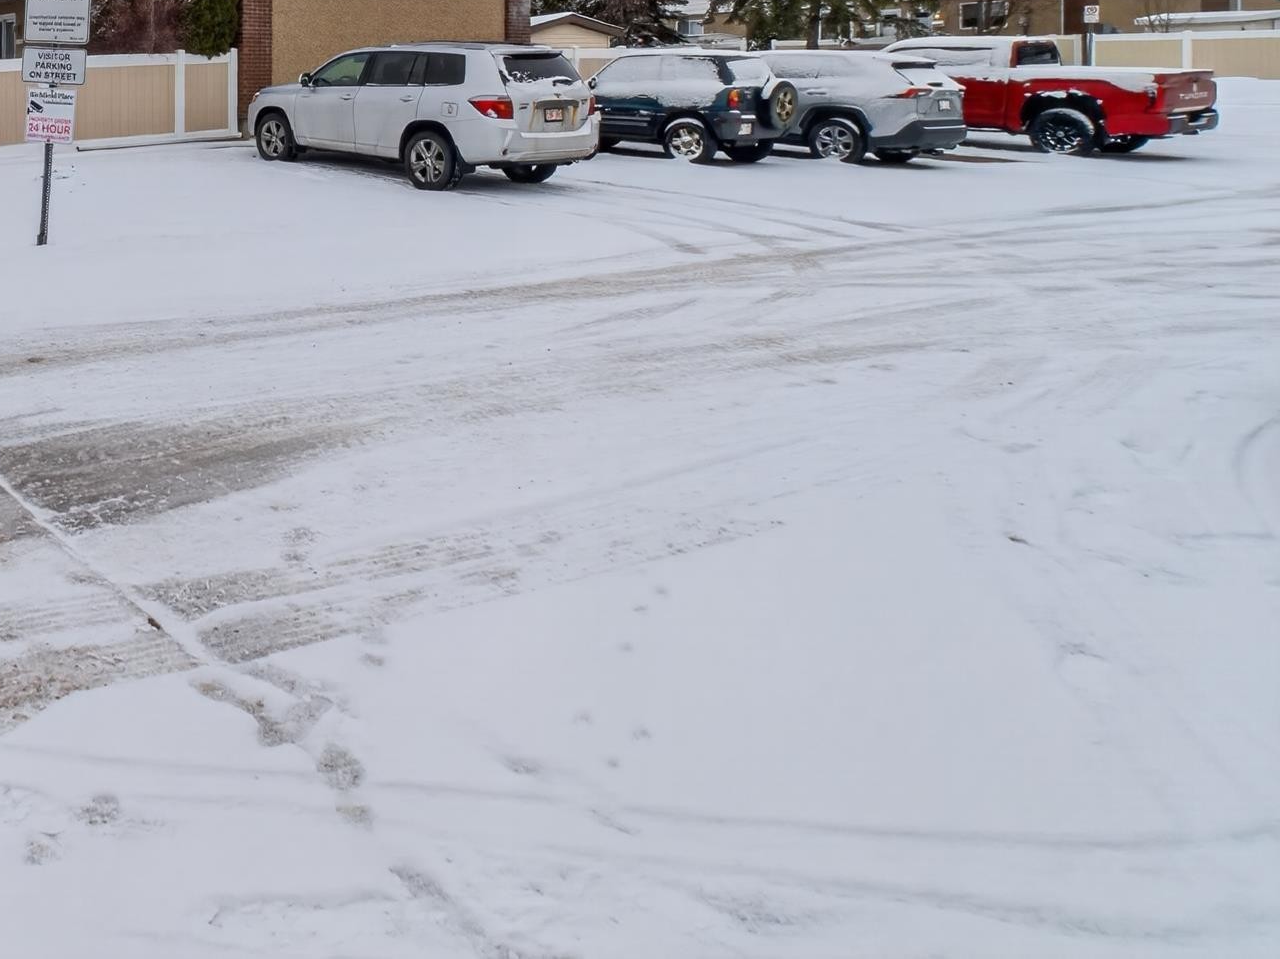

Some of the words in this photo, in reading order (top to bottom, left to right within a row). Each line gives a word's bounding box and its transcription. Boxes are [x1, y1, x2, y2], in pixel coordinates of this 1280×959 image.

[37, 52, 71, 61] VISITOR
[35, 62, 72, 71] PARKING
[44, 72, 77, 81] STREET
[28, 122, 39, 131] 24
[42, 123, 71, 134] HOUR
